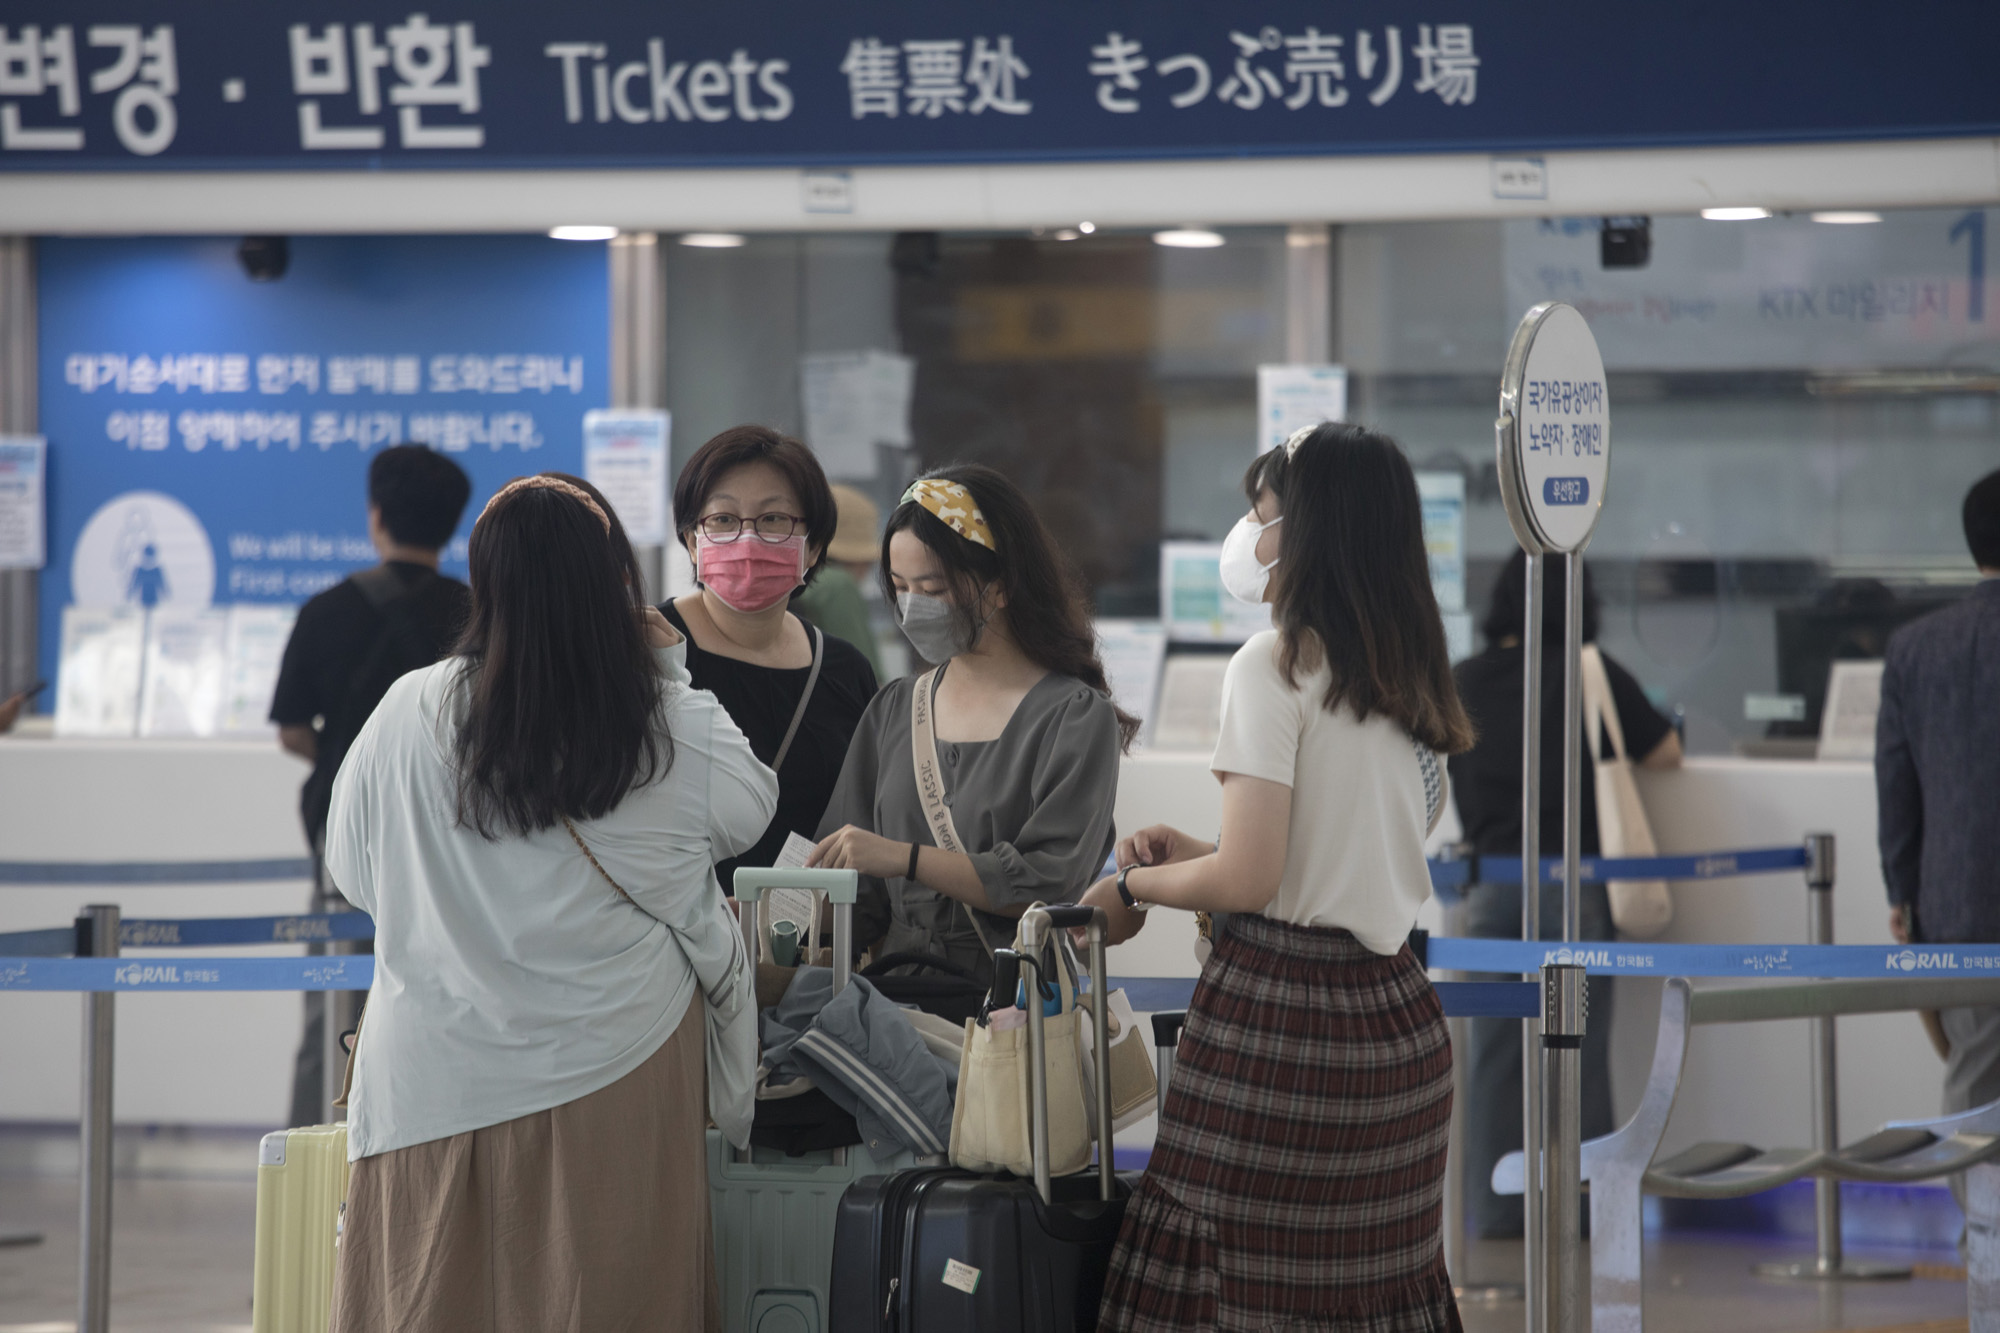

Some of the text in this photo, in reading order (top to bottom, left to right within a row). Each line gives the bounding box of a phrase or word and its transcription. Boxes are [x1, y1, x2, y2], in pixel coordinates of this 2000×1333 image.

[0, 24, 178, 155] 변경
[290, 15, 489, 149] 반환
[545, 39, 794, 124] Tickets
[840, 37, 1032, 118] 售票处
[1089, 24, 1480, 112] きっぷ売り場
[1949, 210, 1985, 323] 1
[1529, 380, 1602, 415] 국가유공상이자
[115, 964, 180, 985] KORAIL
[1886, 951, 1959, 971] KORAIL
